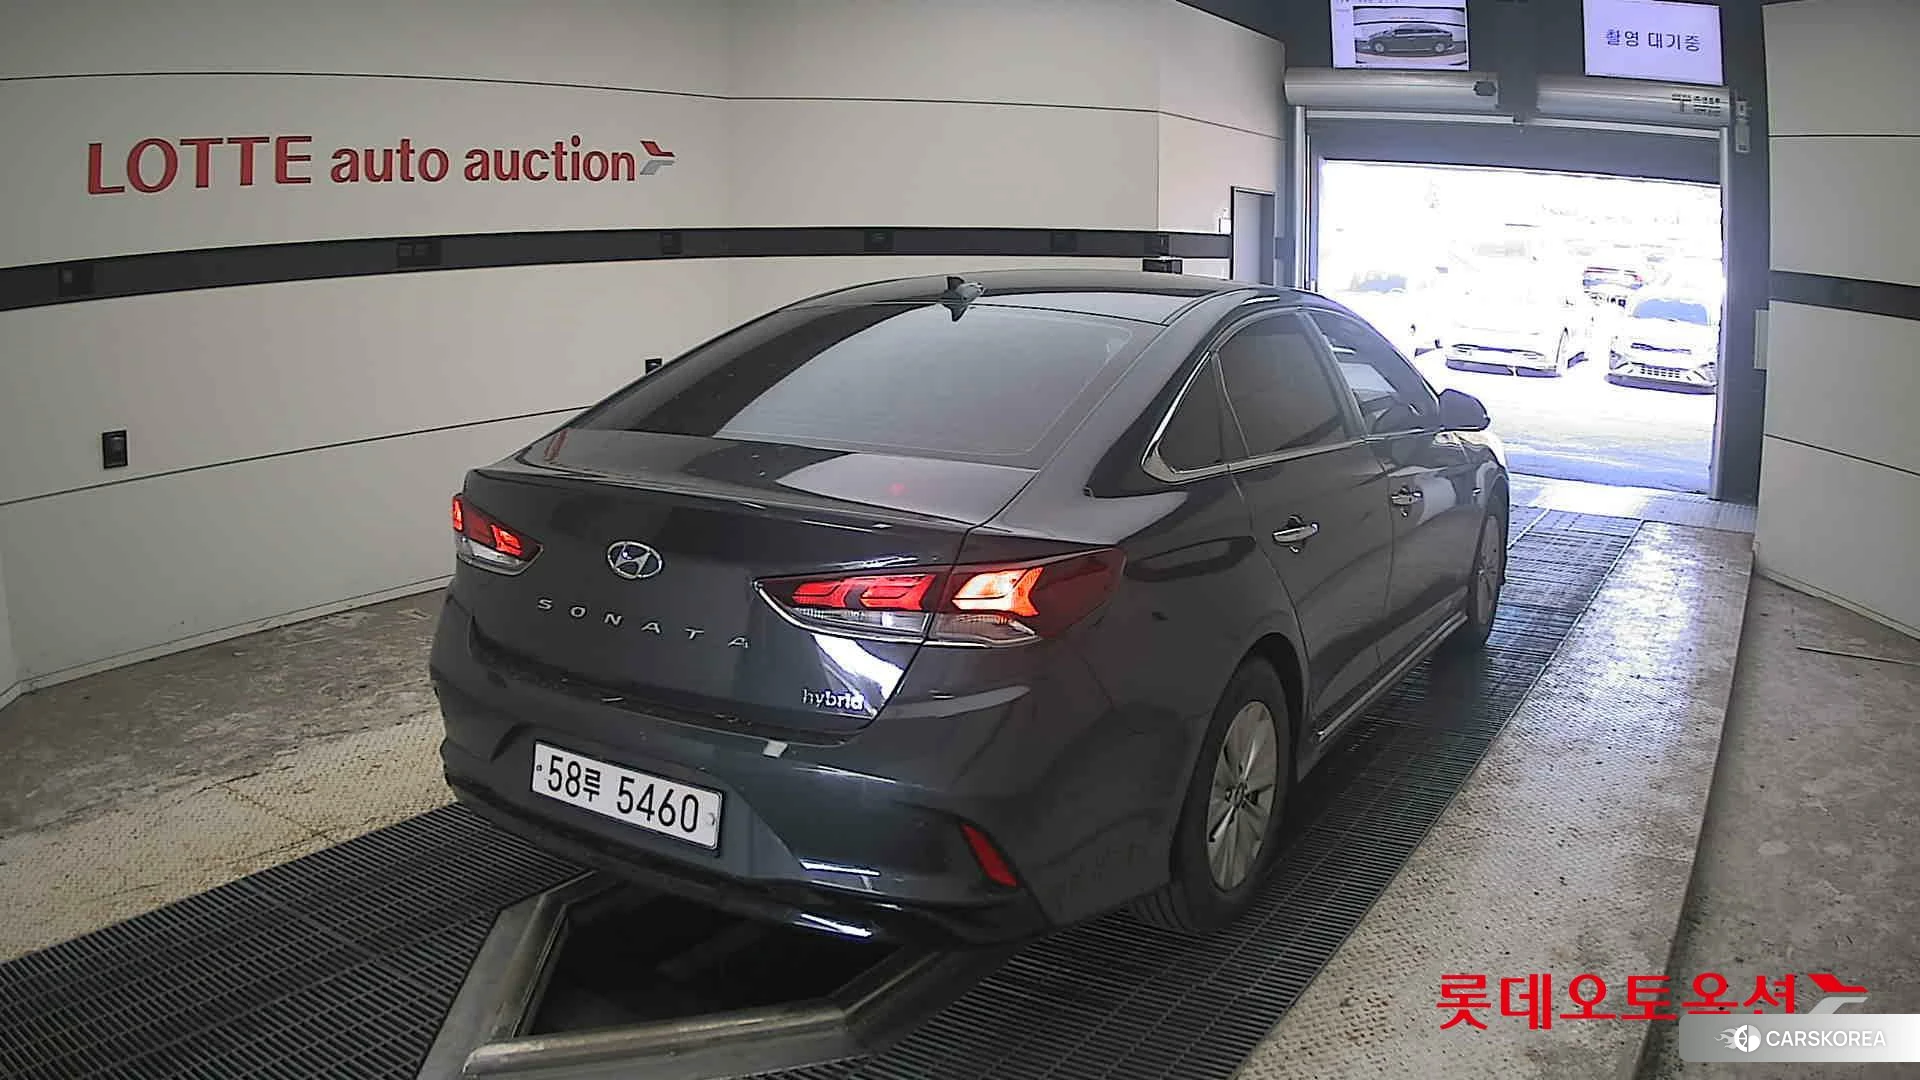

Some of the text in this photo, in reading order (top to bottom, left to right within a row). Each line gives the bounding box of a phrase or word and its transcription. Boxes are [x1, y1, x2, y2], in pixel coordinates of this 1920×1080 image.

[1648, 32, 1701, 52] 대기중
[86, 135, 637, 195] LOTTE auto auction
[537, 598, 750, 649] SONATA
[802, 688, 865, 711] hybrid
[547, 754, 700, 833] 58루 5460
